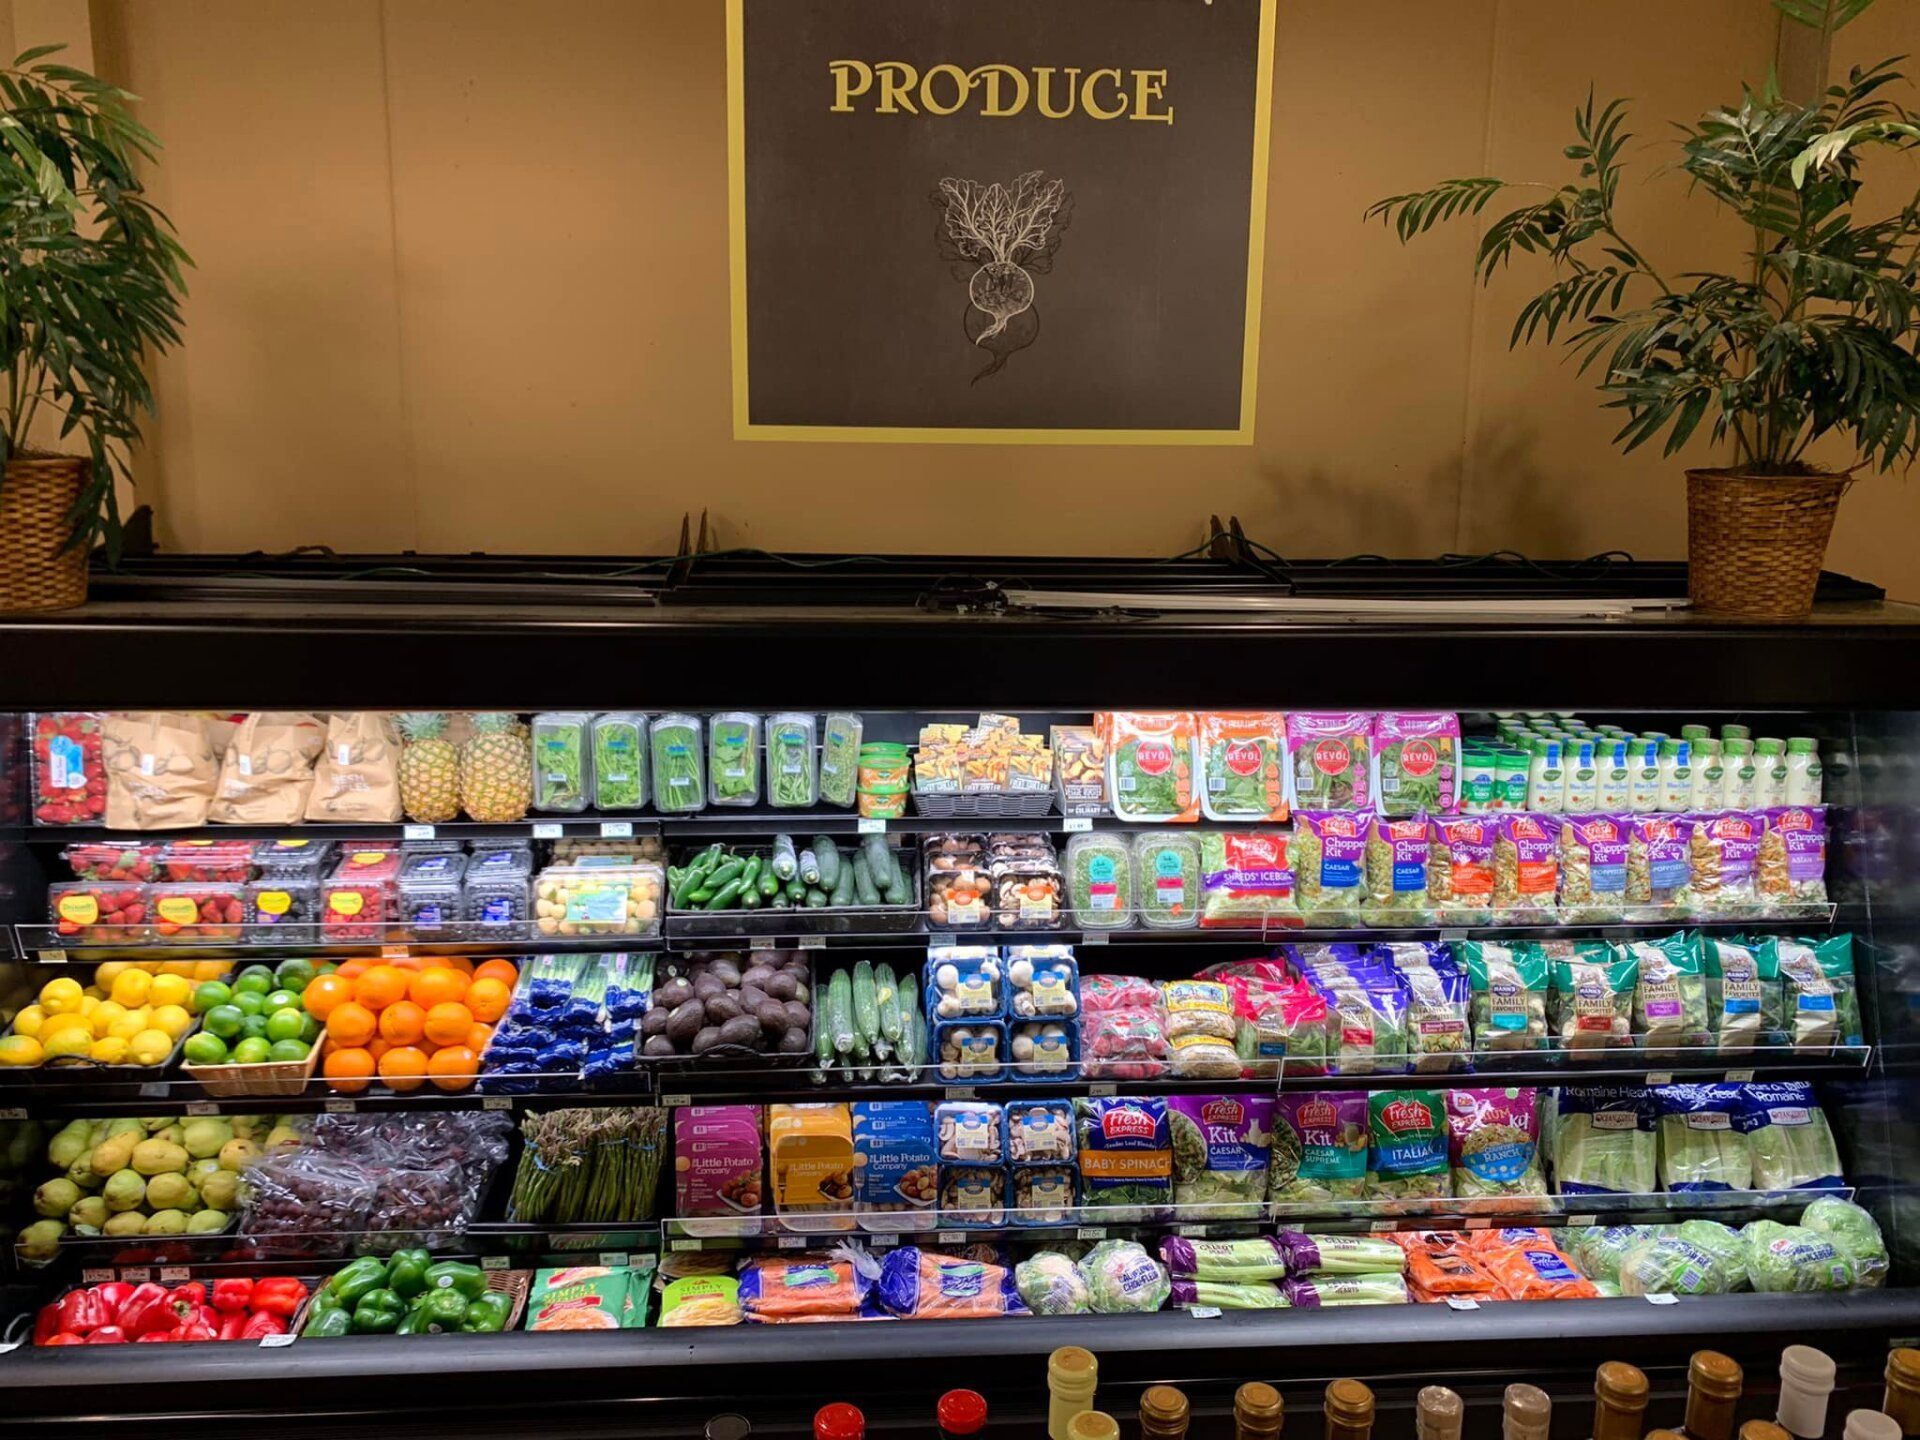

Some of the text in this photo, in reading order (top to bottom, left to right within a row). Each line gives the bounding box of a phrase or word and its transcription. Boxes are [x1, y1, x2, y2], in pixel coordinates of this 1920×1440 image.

[829, 60, 1175, 125] PRODUCE
[1138, 751, 1171, 761] REVOL
[1228, 752, 1261, 761] REVOL
[1316, 751, 1348, 762] REVOL
[1402, 753, 1434, 763] REVOL
[1788, 840, 1805, 850] Kit
[1325, 847, 1342, 858] Kit
[1396, 852, 1412, 862] Kit
[1520, 851, 1534, 860] Kit
[1725, 848, 1741, 858] Kit
[1594, 853, 1608, 863] Kit
[1324, 863, 1350, 871] CAESAR
[1643, 984, 1677, 993] FAMILY
[1725, 982, 1759, 991] FAMILY
[1491, 997, 1526, 1006] FAMILY
[1578, 1000, 1612, 1008] FAMILY
[1619, 1087, 1655, 1098] Heart
[1208, 1103, 1238, 1115] Fresh
[1303, 1105, 1331, 1116] Fresh
[1389, 1105, 1423, 1119] Fresh
[1109, 1114, 1149, 1126] Fresh
[1208, 1114, 1239, 1122] EXPRESS
[1303, 1115, 1332, 1124] EXPRESS
[1391, 1117, 1426, 1128] EXPRESS
[1110, 1125, 1150, 1135] EXPRESS
[1208, 1126, 1237, 1144] Kit
[1304, 1129, 1332, 1146] Kit
[1210, 1146, 1242, 1155] CAESAR
[1305, 1149, 1335, 1157] CAESAR
[1483, 1148, 1520, 1162] RANCH
[696, 1156, 722, 1168] Little
[723, 1157, 754, 1167] Potato
[873, 1153, 900, 1164] Little
[900, 1153, 930, 1163] Potato
[1084, 1157, 1116, 1169] BABY
[1304, 1155, 1340, 1164] SUPREME
[695, 1167, 731, 1175] Company
[817, 1162, 844, 1170] Potato
[872, 1162, 908, 1171] Company
[680, 1283, 722, 1292] SIMPLY
